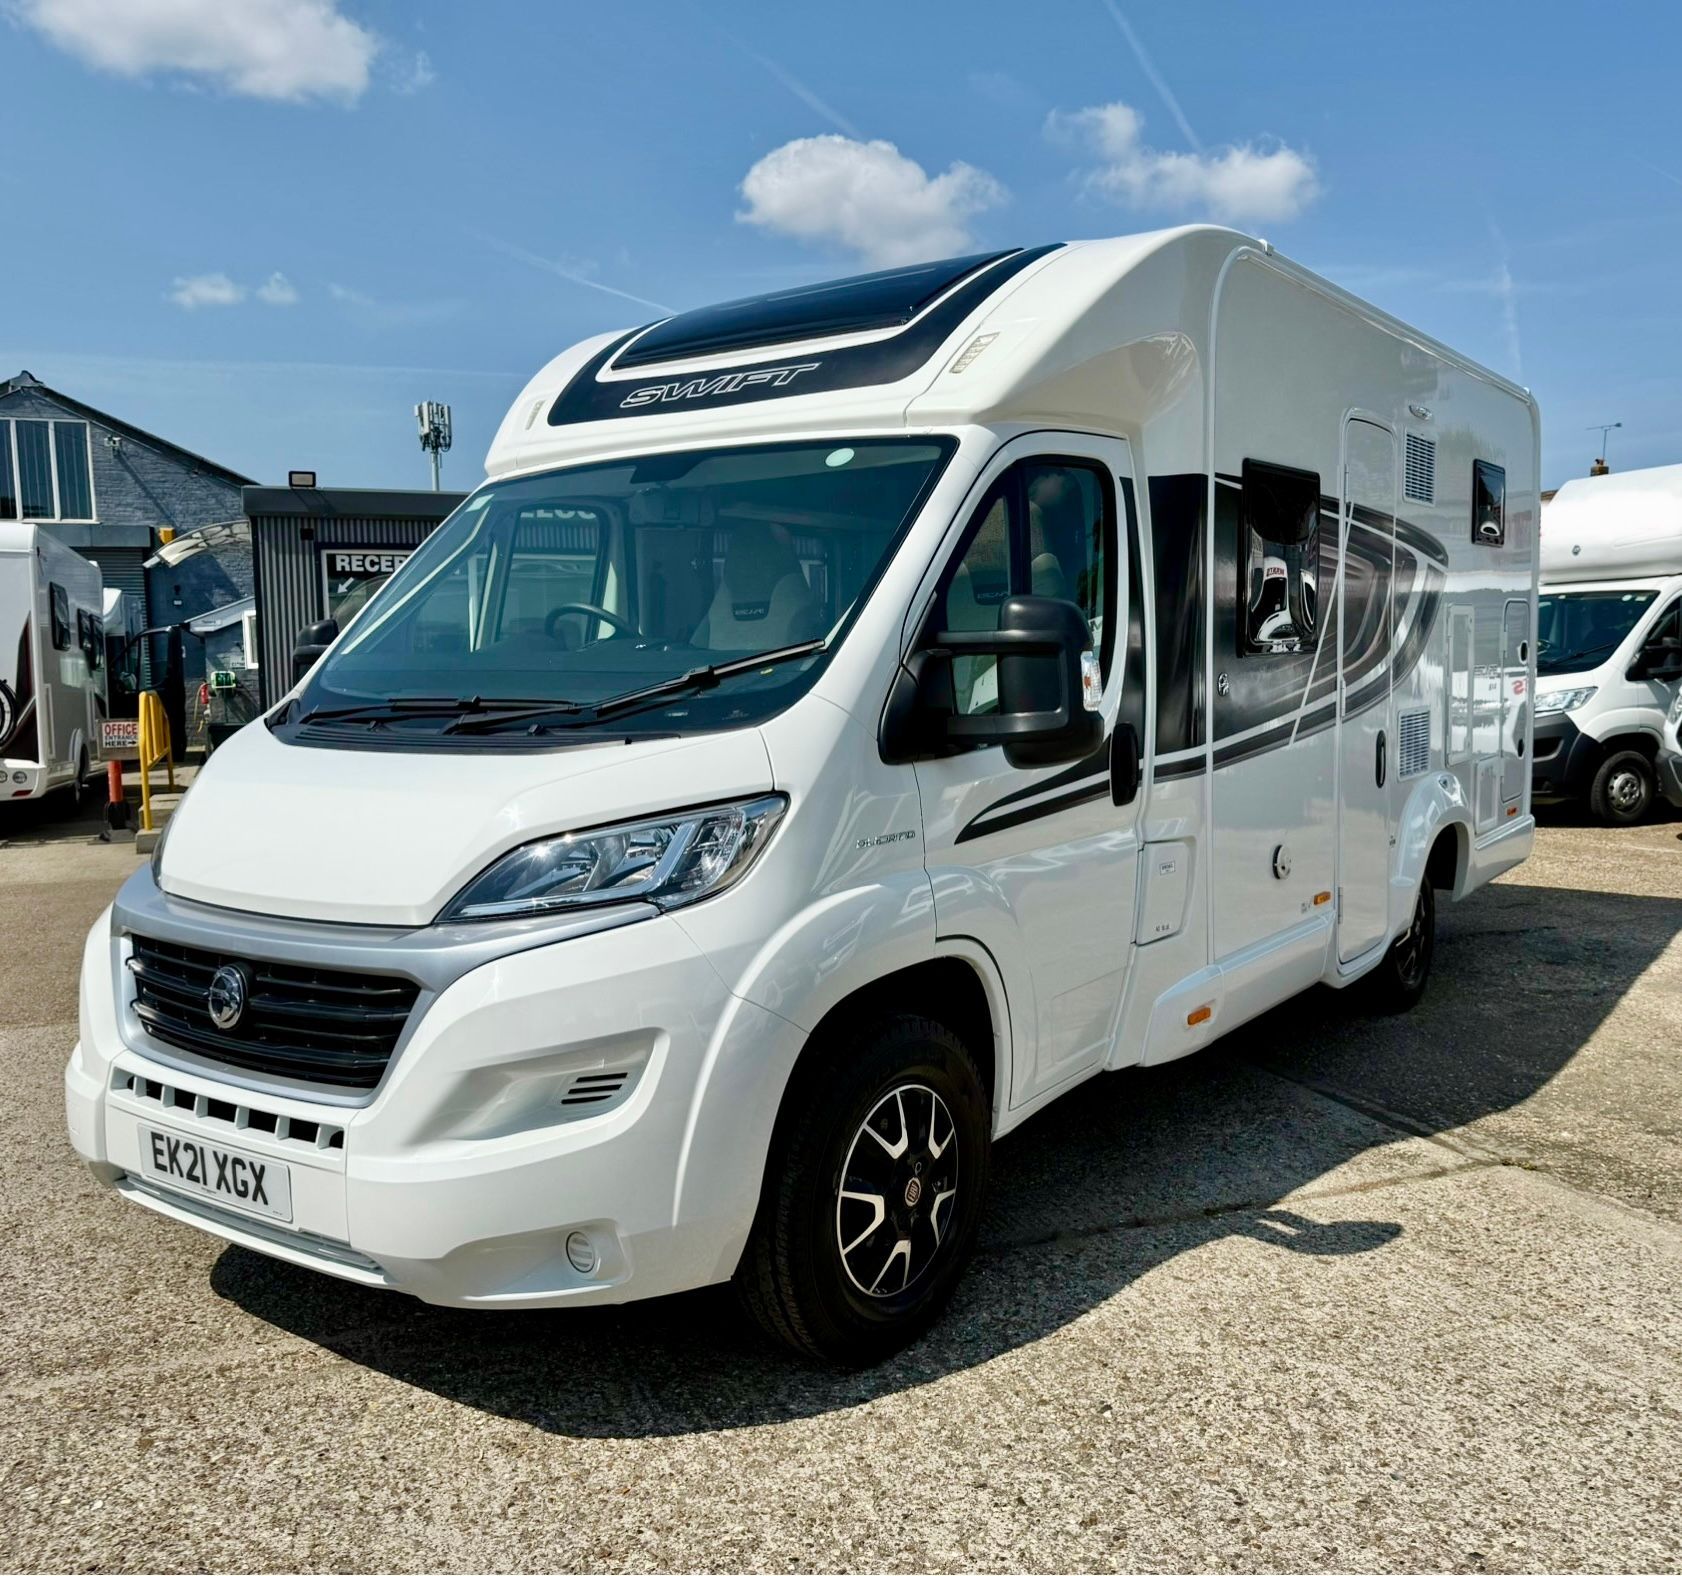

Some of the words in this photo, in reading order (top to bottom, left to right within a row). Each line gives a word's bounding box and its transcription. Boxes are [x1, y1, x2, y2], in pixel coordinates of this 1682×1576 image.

[619, 362, 823, 409] SWIFT
[104, 723, 138, 735] OFFICE
[150, 1131, 208, 1187] EK21
[212, 1150, 269, 1206] XGX
